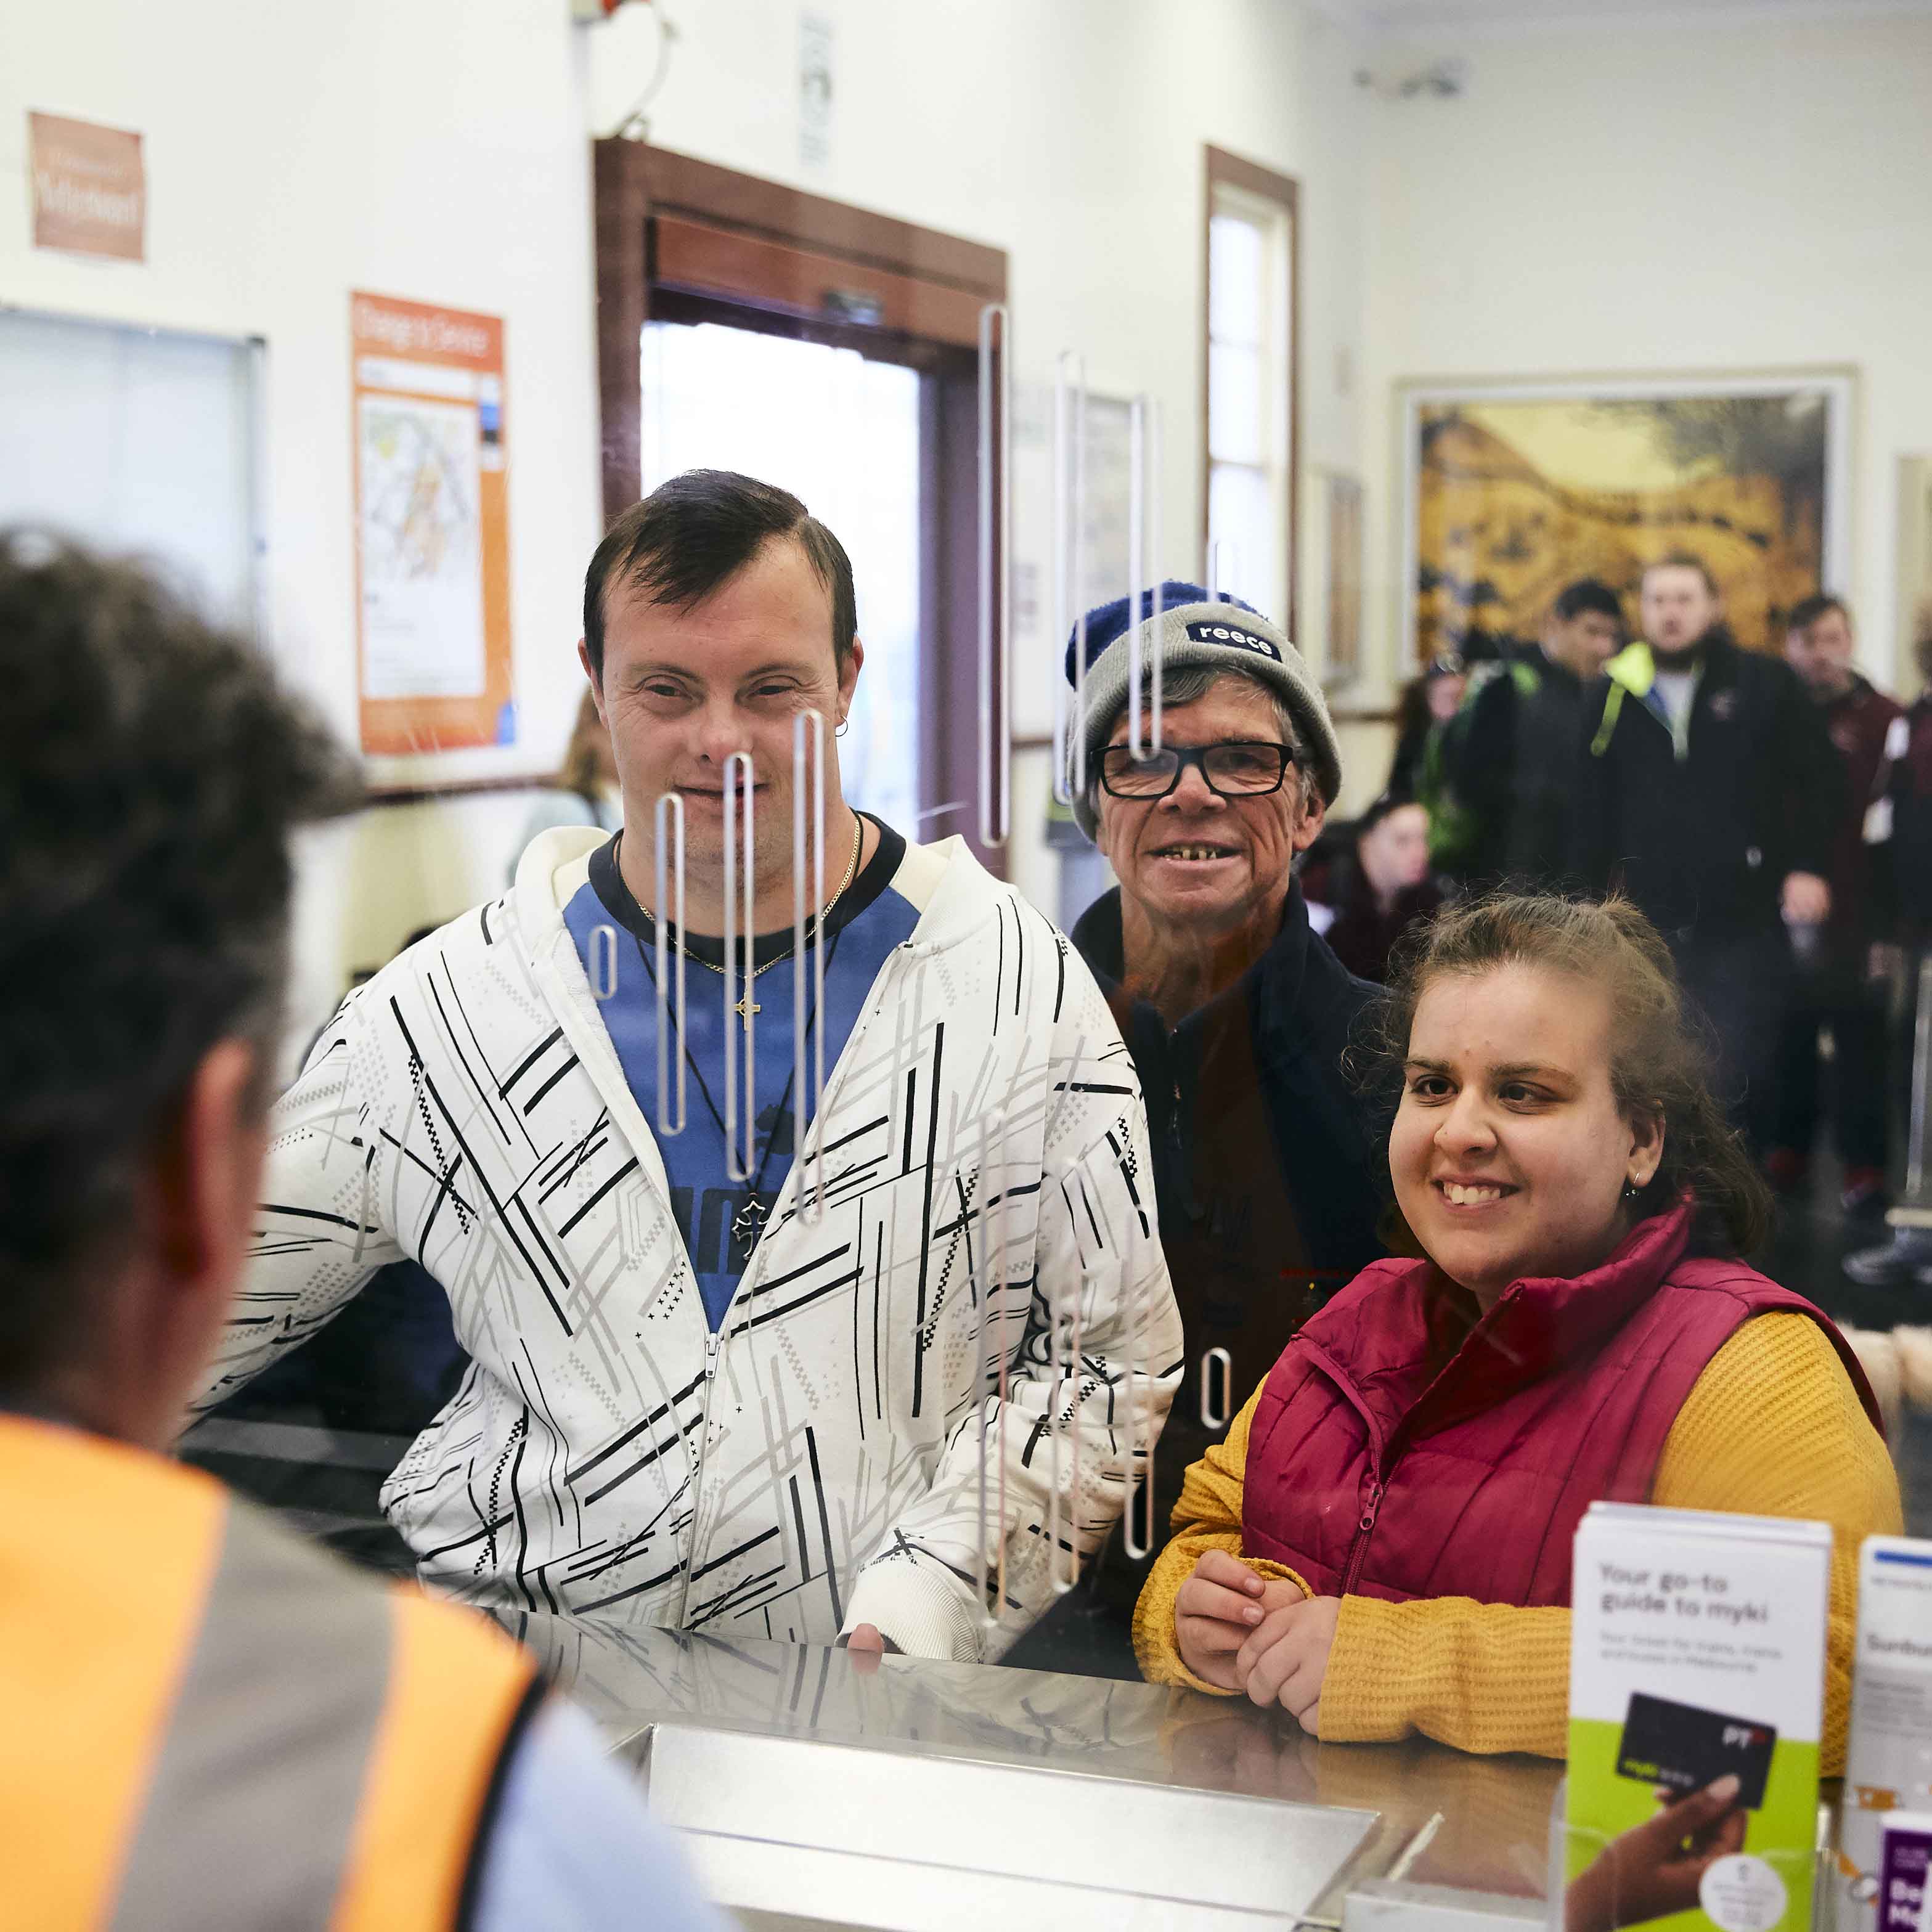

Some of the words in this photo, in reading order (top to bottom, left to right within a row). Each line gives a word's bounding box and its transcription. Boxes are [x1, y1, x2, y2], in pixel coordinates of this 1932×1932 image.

[1199, 626, 1273, 655] reece
[1600, 1562, 1650, 1586] Your
[1659, 1573, 1728, 1594] go-to
[1601, 1593, 1666, 1615] guide
[1674, 1597, 1701, 1617] to
[1707, 1604, 1767, 1627] myki
